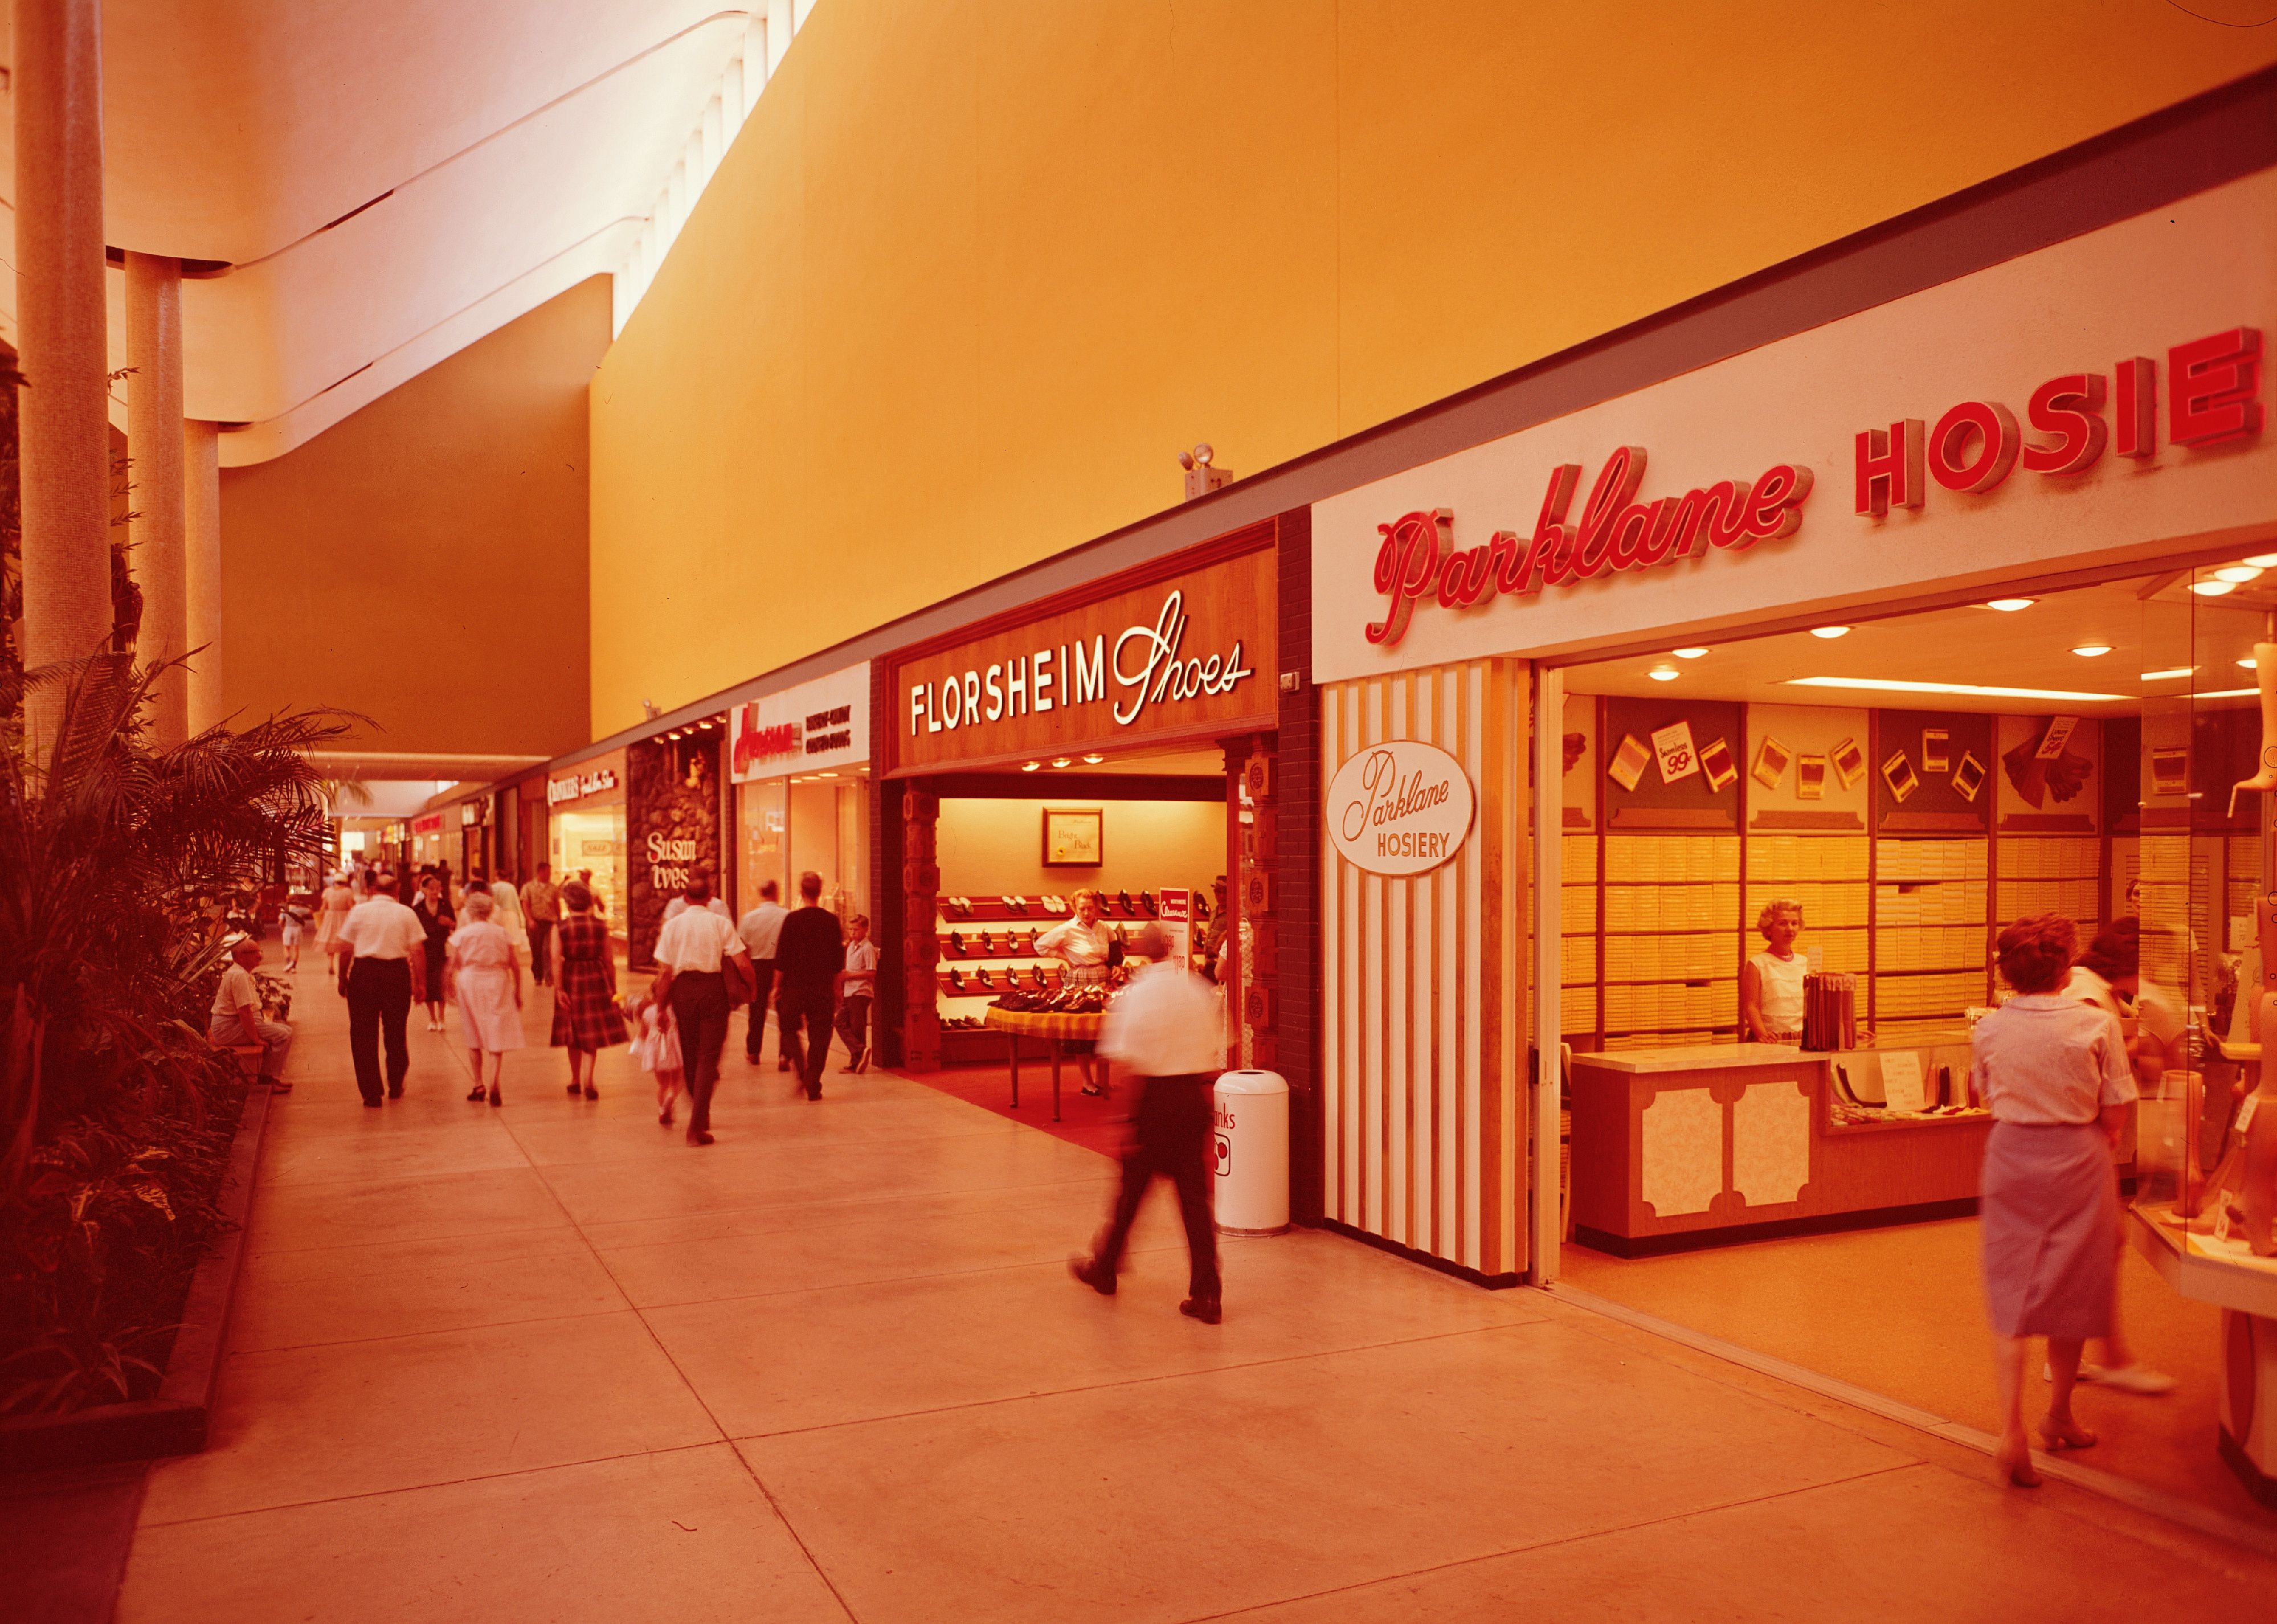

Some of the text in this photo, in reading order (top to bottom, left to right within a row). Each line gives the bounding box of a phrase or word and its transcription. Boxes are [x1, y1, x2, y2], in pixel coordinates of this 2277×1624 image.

[1366, 446, 1815, 647] Parklane
[911, 590, 1252, 736] FLORSHEIM Shoes
[1342, 750, 1449, 842] Parklane
[646, 831, 696, 864] Susan
[1377, 832, 1450, 858] HOSIERY
